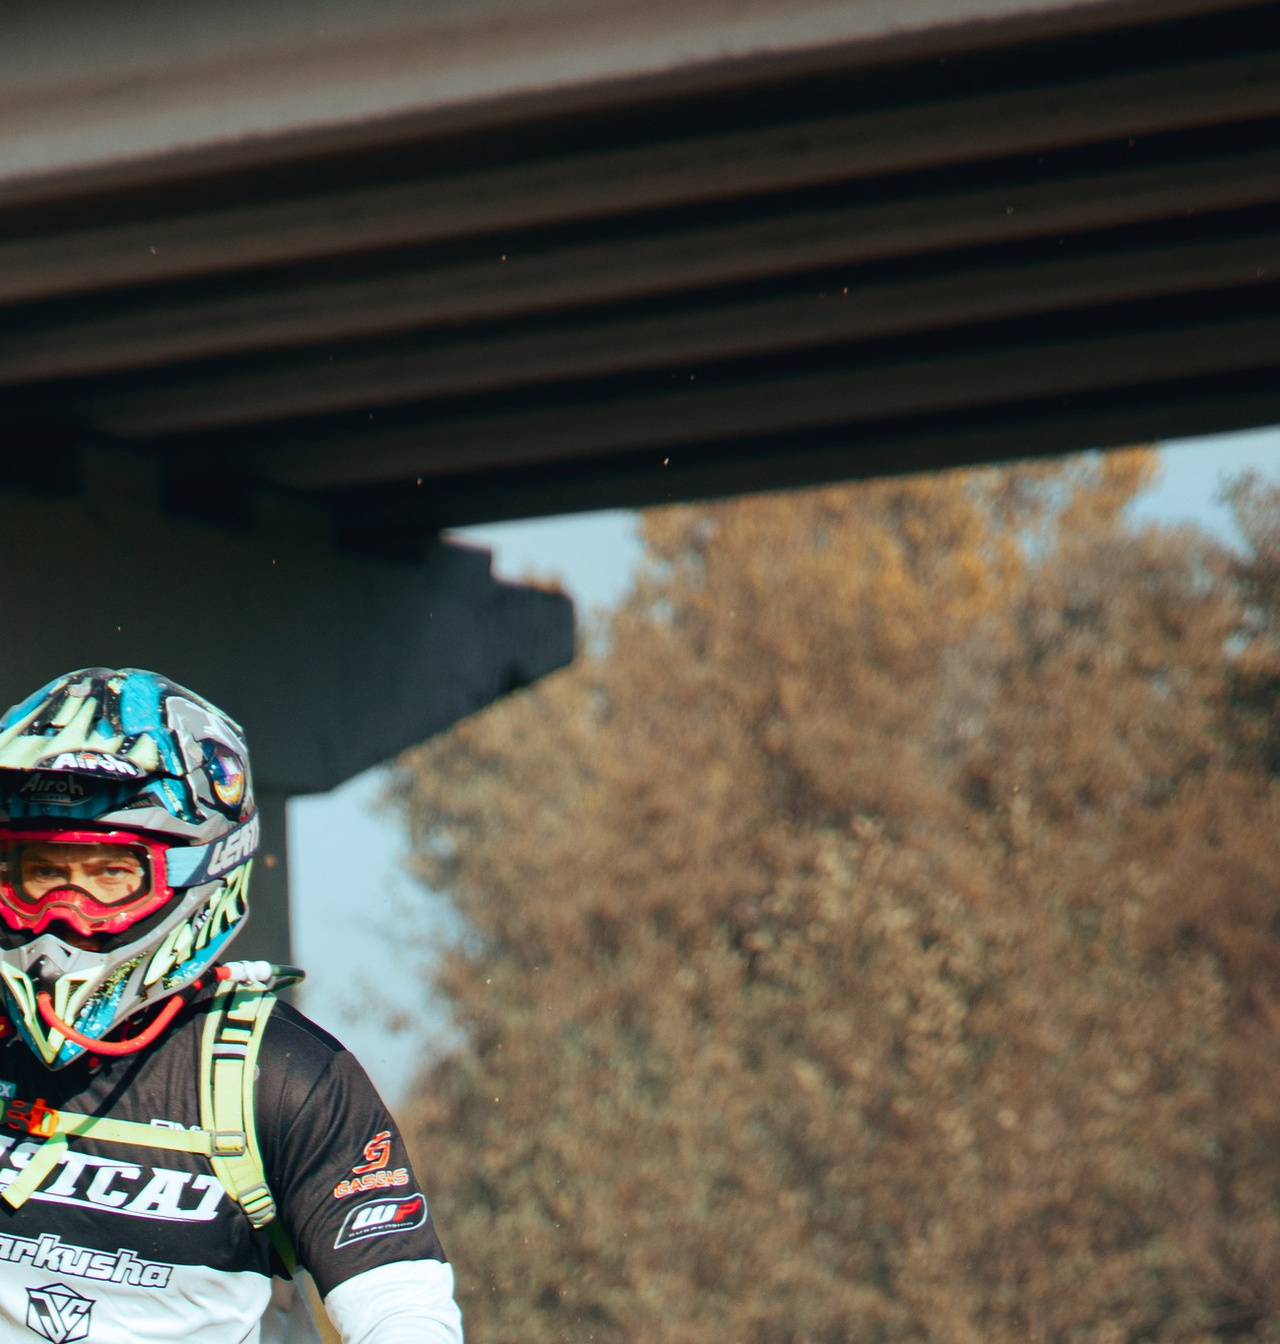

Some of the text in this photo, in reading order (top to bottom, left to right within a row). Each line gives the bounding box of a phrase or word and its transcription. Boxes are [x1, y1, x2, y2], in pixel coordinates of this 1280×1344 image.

[51, 752, 138, 777] Airoh
[20, 772, 85, 796] Airoh
[334, 1167, 409, 1198] GASGAS
[351, 1200, 421, 1231] WP
